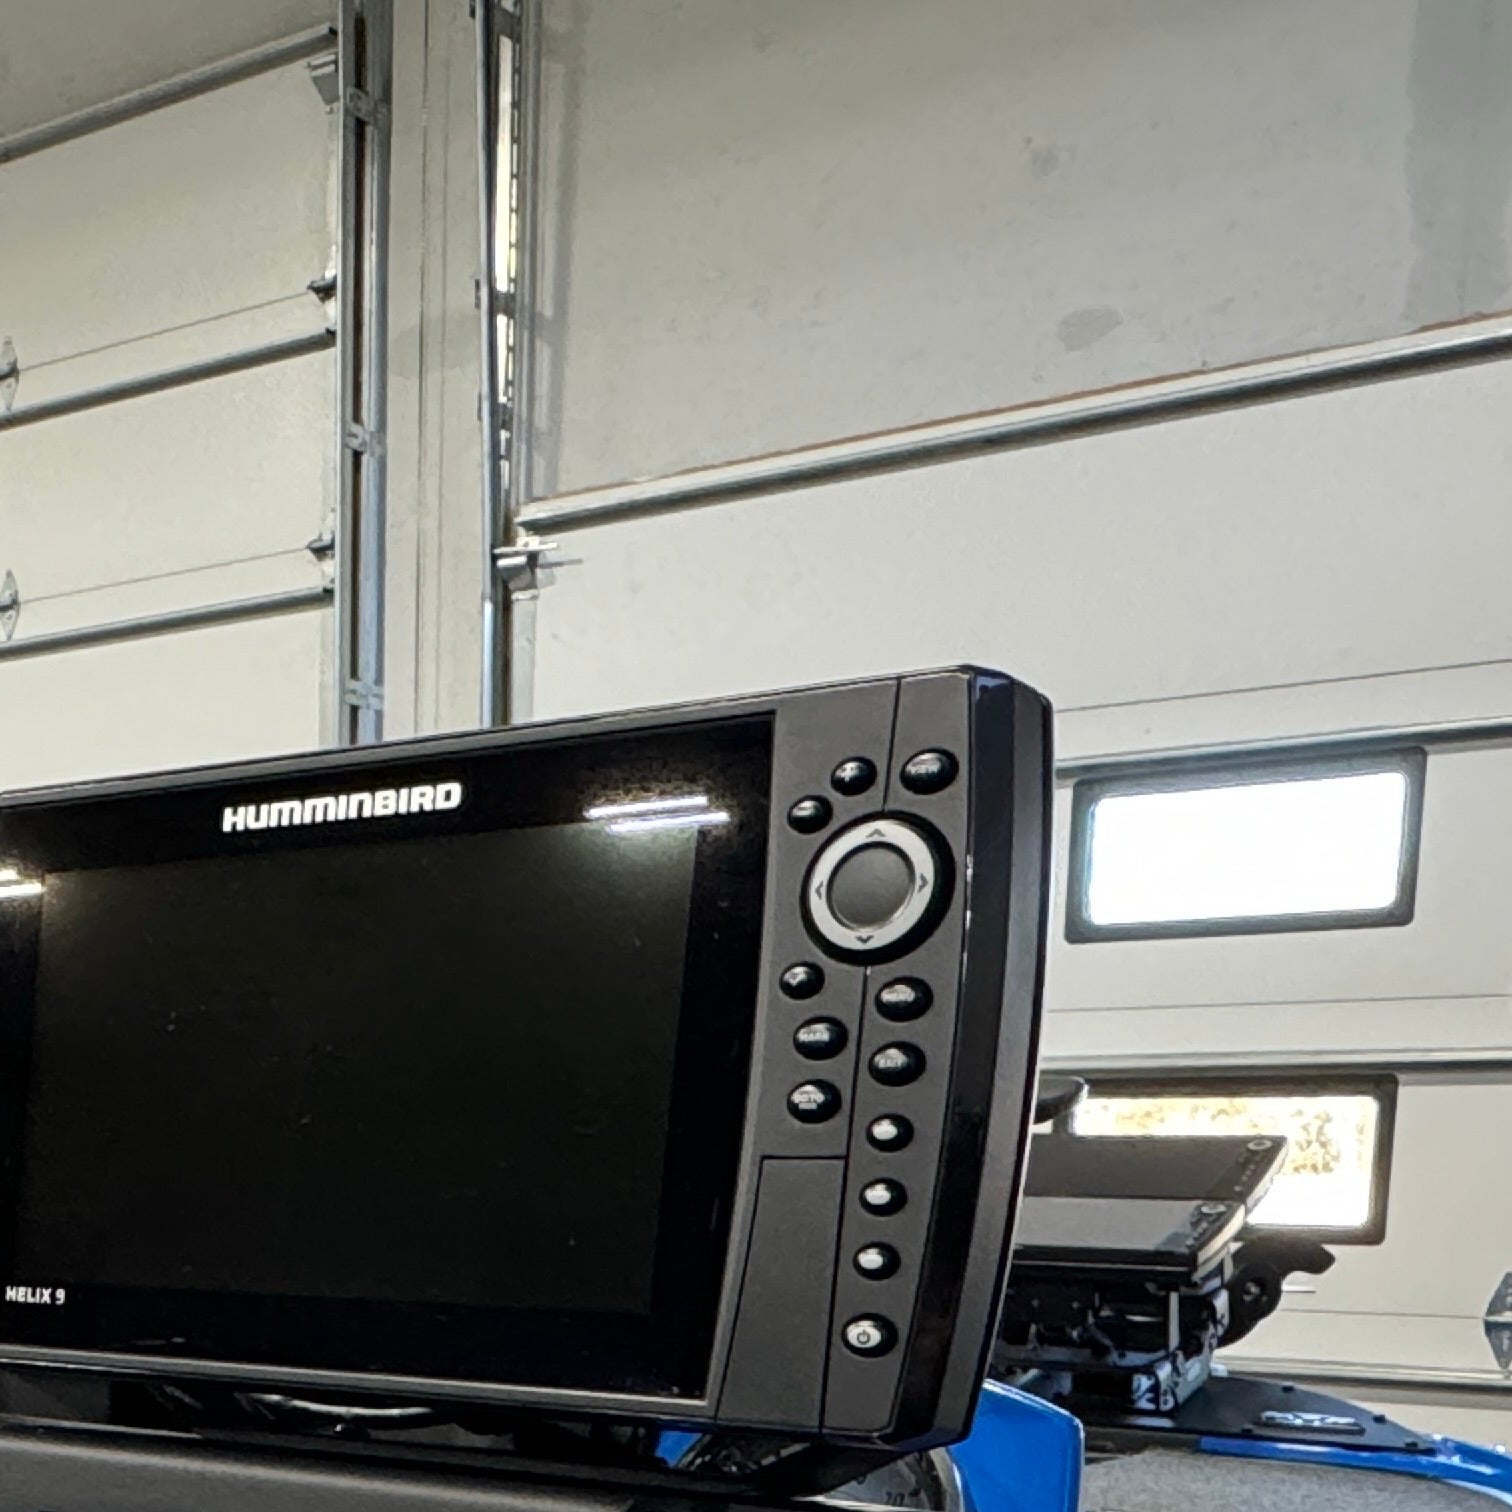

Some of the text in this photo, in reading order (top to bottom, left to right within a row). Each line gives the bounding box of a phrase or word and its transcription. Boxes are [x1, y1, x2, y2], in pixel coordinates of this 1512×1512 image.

[222, 780, 462, 833] HUMMINBIRD
[5, 1285, 66, 1305] HELIX 9
